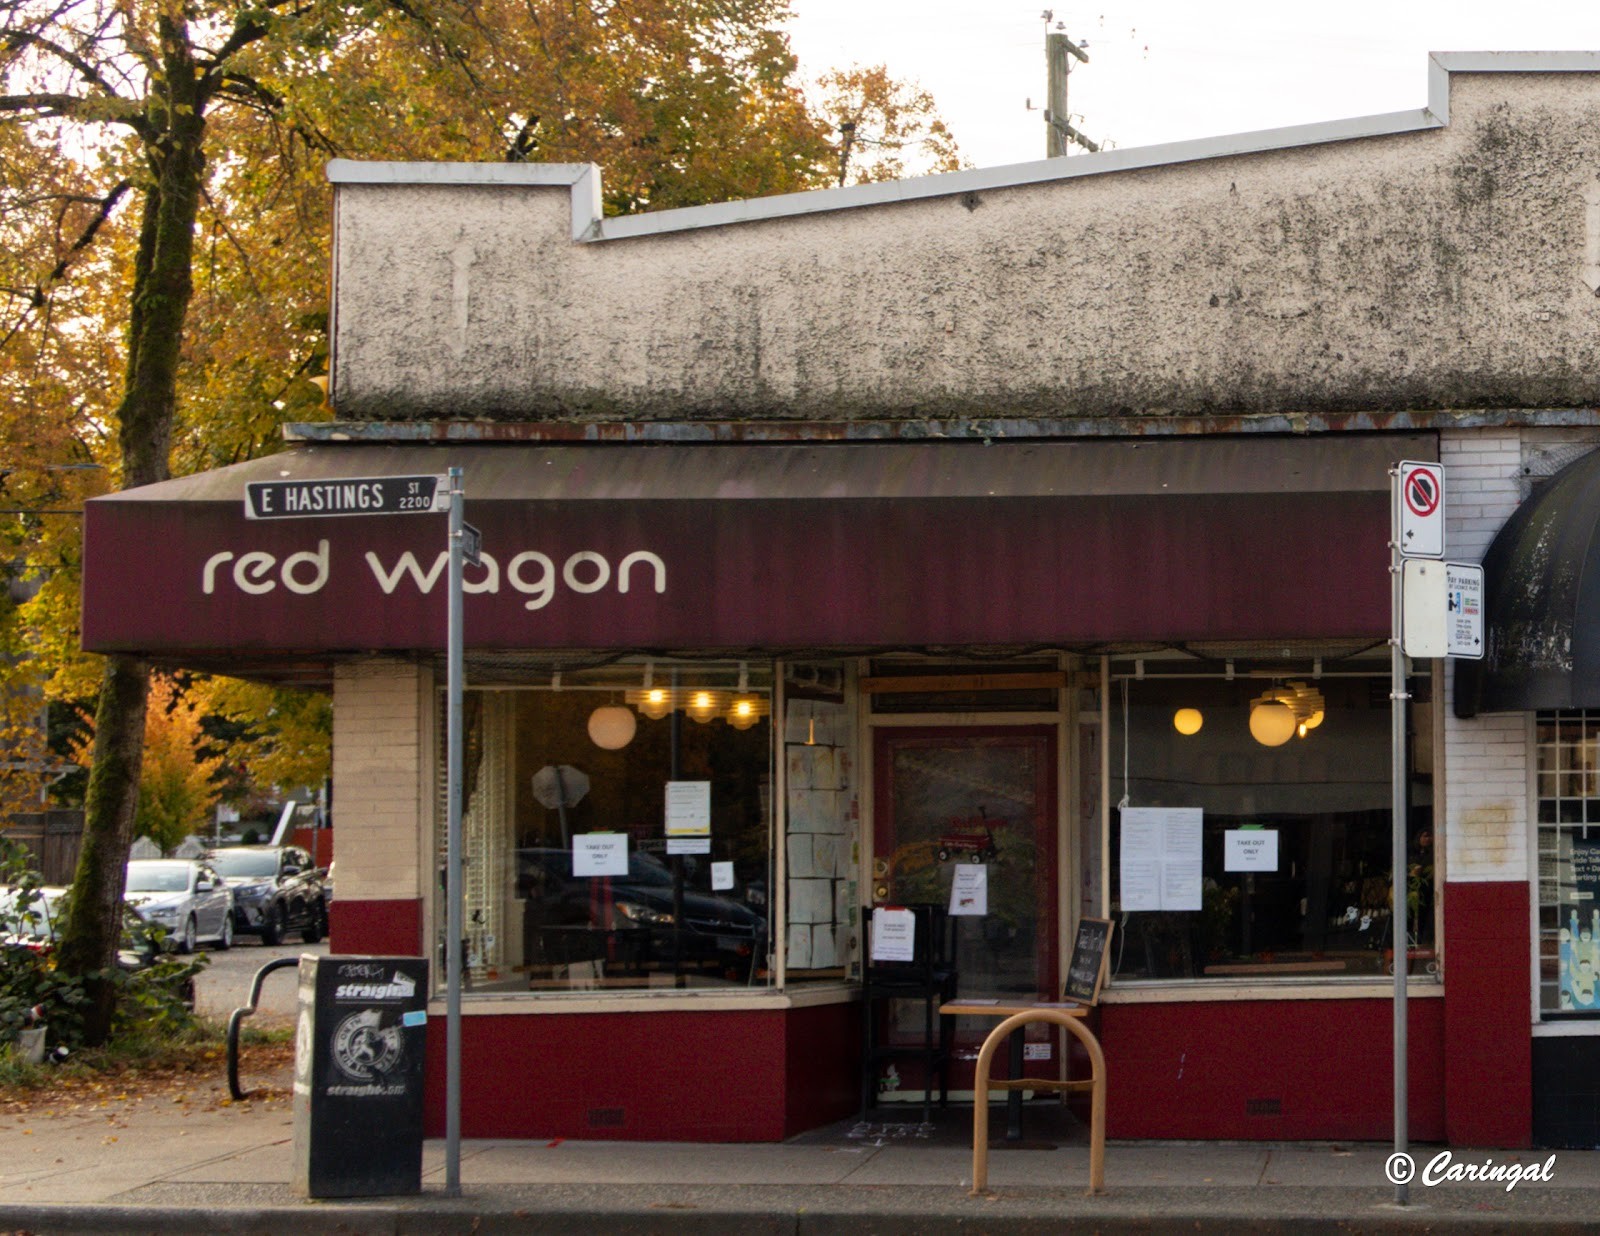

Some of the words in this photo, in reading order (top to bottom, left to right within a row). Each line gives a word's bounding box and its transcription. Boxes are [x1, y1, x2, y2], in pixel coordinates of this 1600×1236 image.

[408, 482, 420, 494] ST
[262, 488, 273, 512] E
[285, 484, 384, 511] HASTINGS
[399, 496, 431, 509] 2200
[203, 538, 330, 594] red
[364, 550, 666, 610] wagon
[1458, 577, 1480, 587] PARKING
